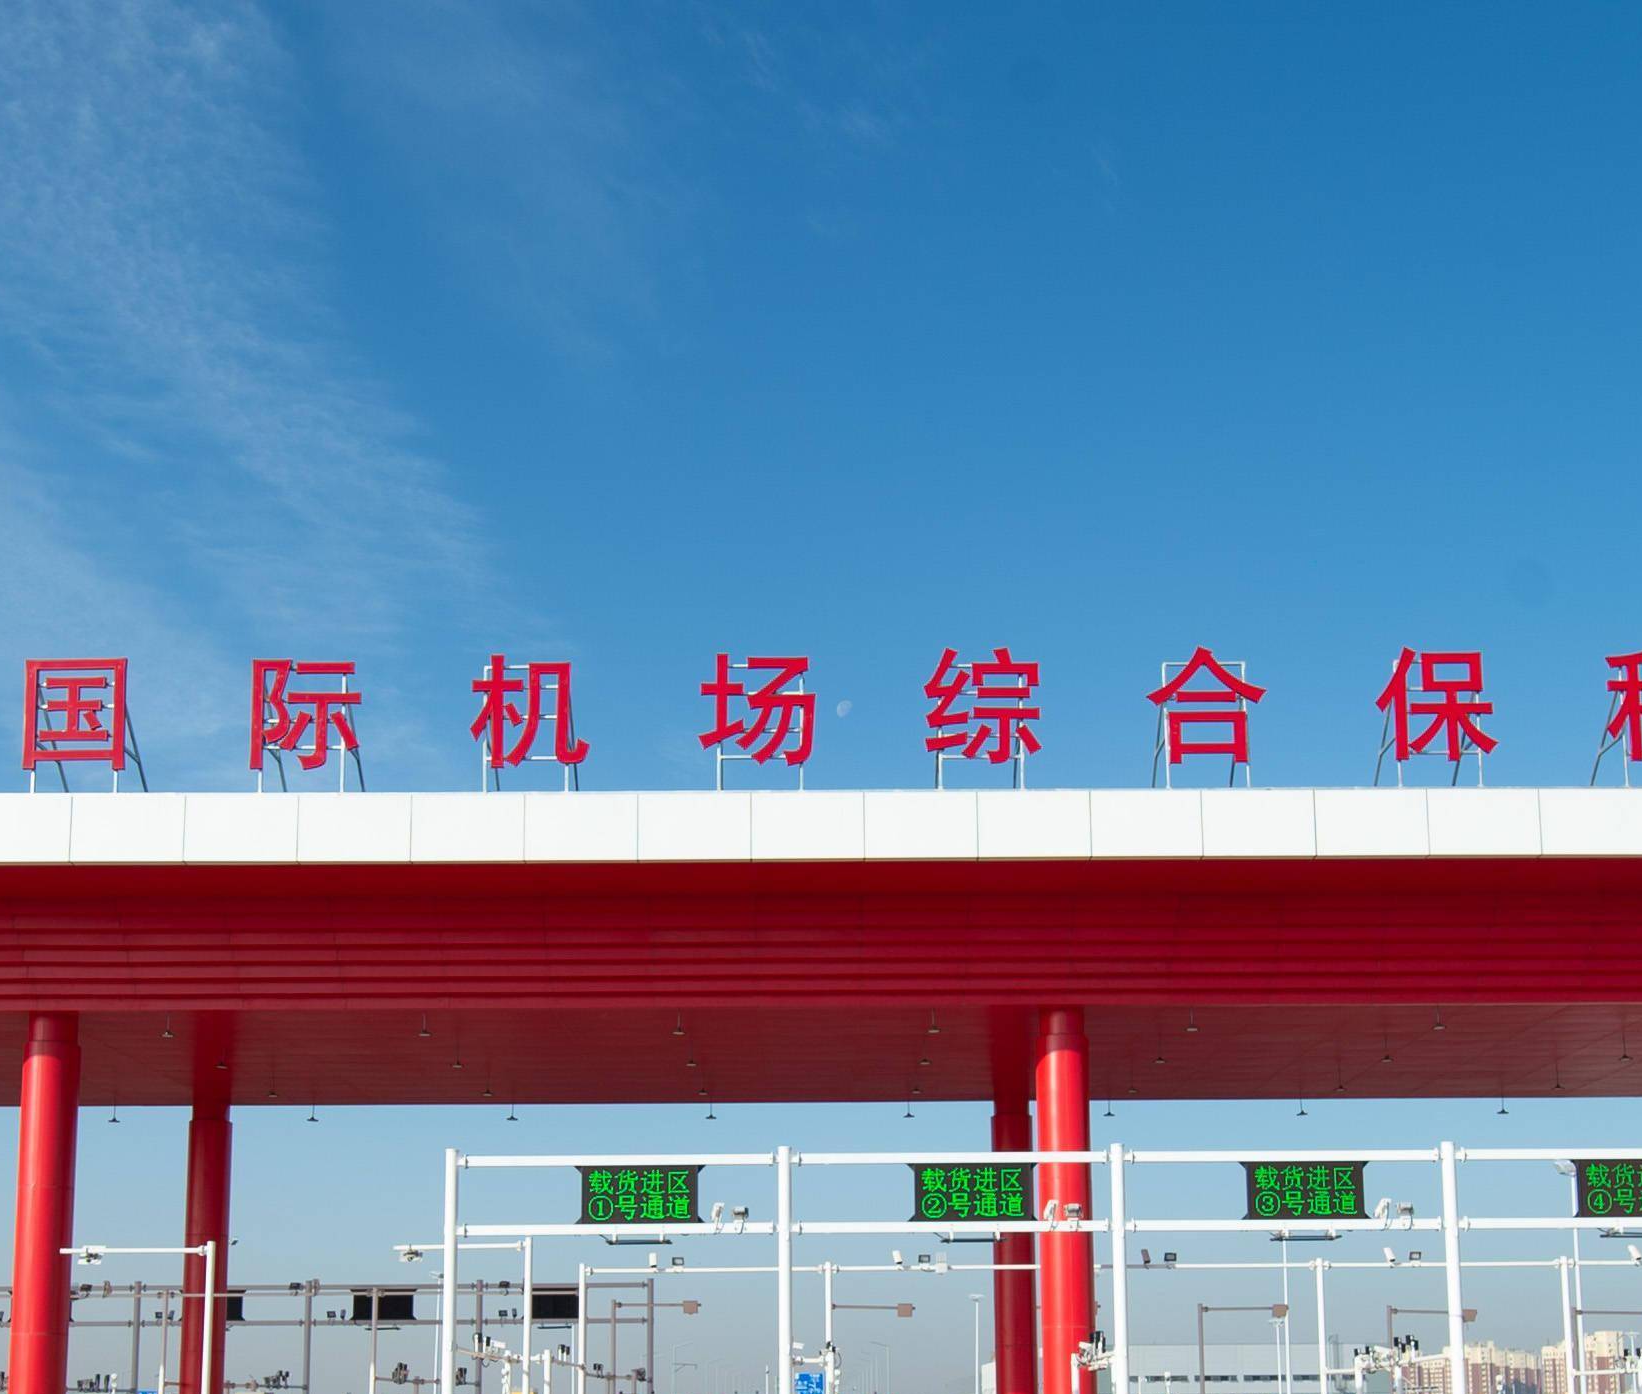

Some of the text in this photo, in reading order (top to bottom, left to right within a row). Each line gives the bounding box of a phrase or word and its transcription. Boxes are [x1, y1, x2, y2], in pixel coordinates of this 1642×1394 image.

[588, 1169, 690, 1195] 载货进区
[921, 1168, 1023, 1192] 载货进区
[1254, 1165, 1355, 1190] 载货进区
